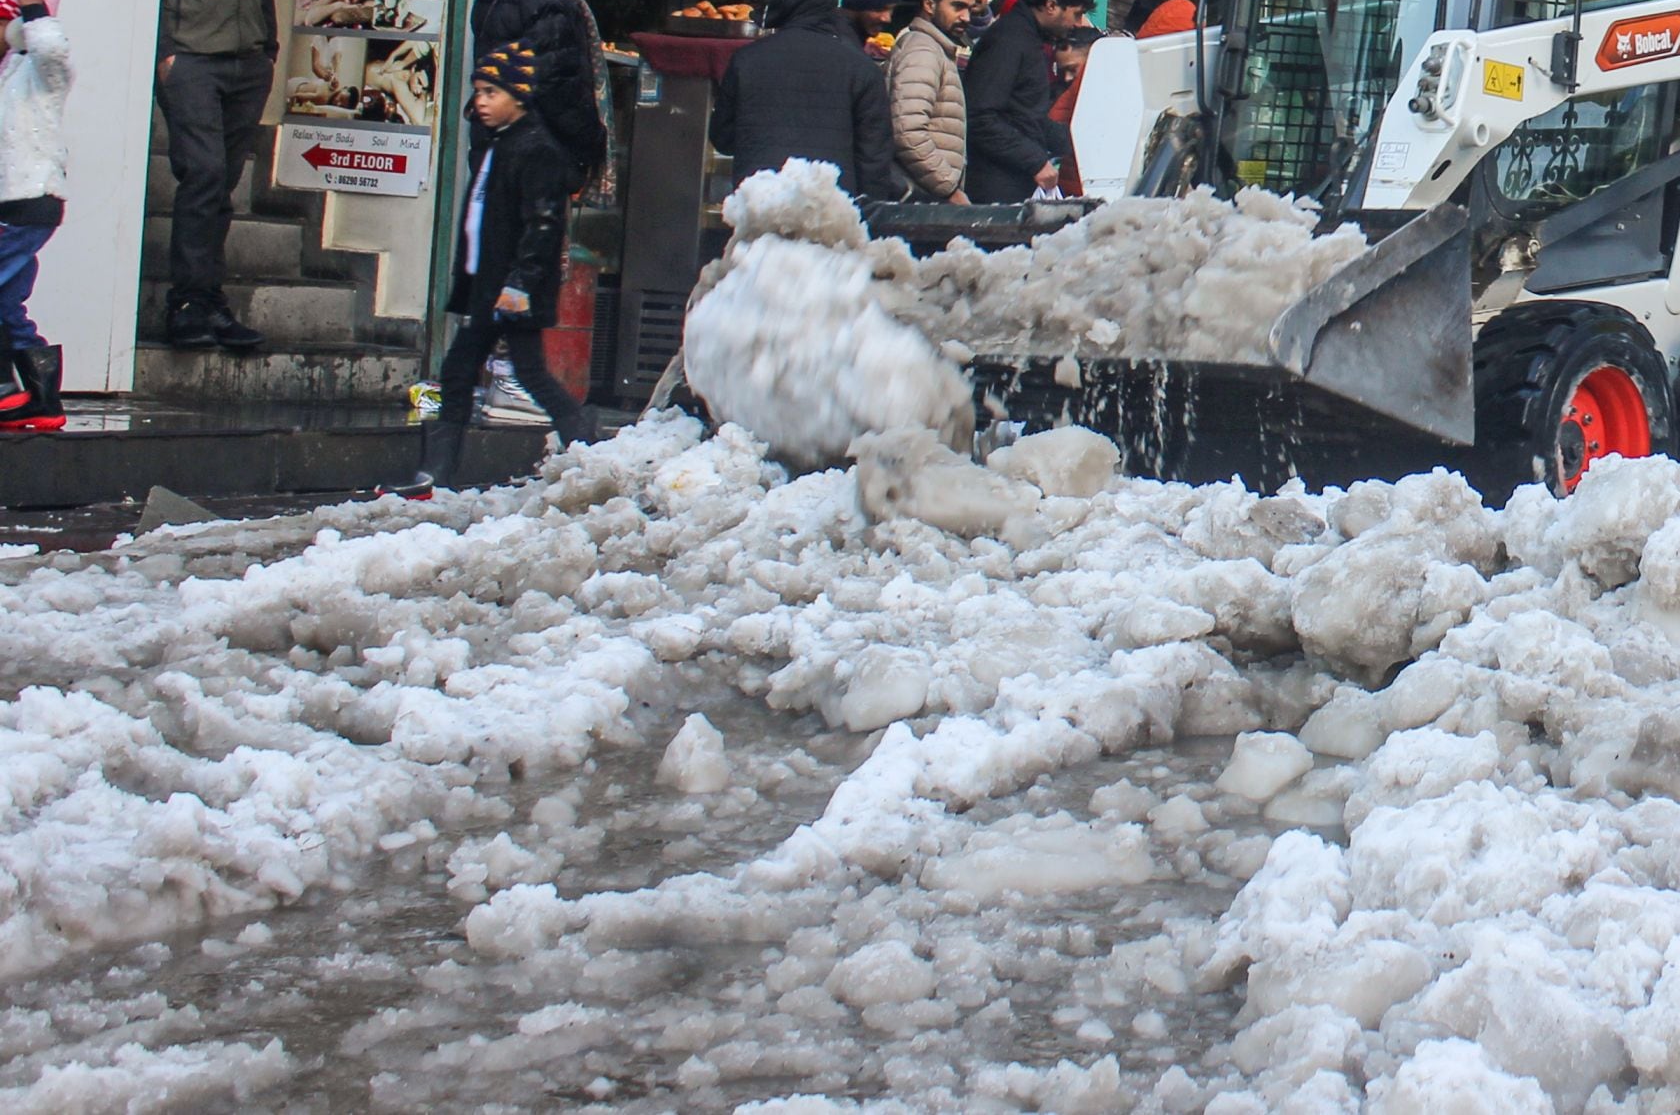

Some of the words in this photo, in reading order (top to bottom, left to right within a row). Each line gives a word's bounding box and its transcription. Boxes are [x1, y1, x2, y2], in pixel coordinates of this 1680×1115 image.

[1634, 28, 1673, 55] Bobcat
[292, 129, 313, 140] Relax
[315, 131, 333, 142] Your
[335, 133, 355, 146] Body
[372, 136, 389, 146] Soul
[400, 138, 420, 149] Mind
[330, 152, 350, 166] 3rd
[353, 156, 394, 170] FLOOR
